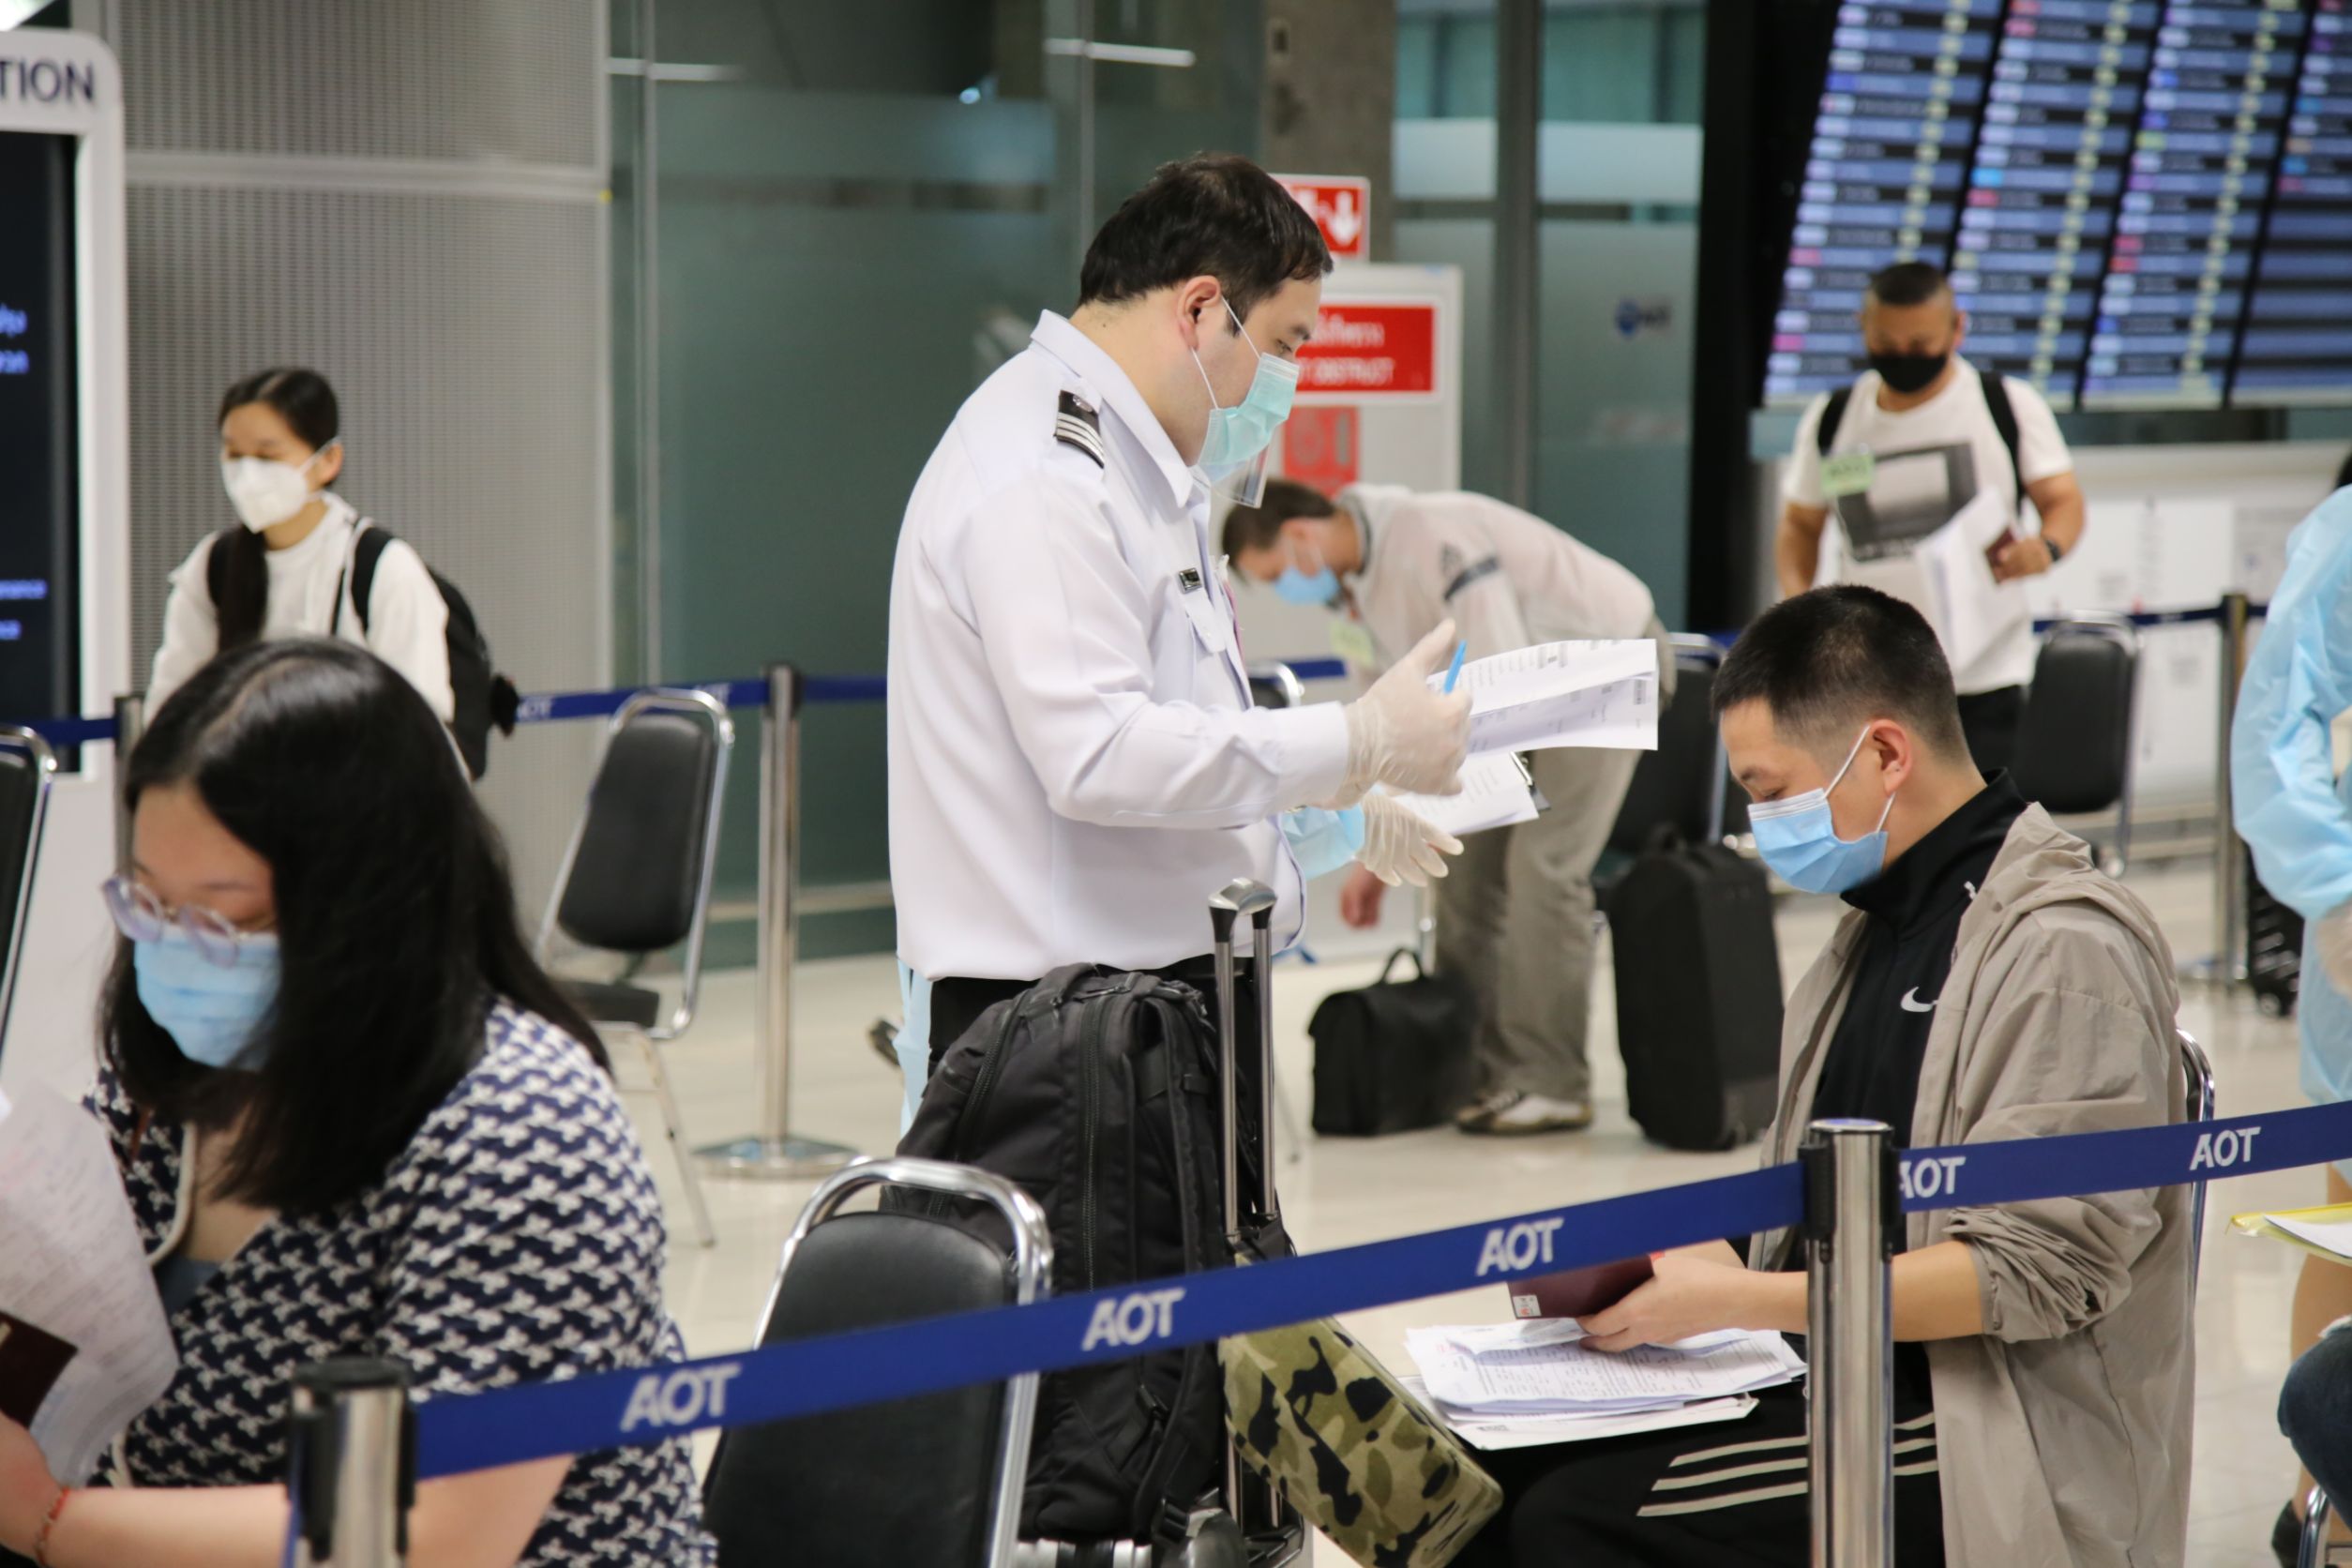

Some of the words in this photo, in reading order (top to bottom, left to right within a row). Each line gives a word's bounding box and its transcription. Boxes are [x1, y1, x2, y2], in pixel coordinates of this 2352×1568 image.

[2189, 1126, 2261, 1170] AOT
[1476, 1217, 1563, 1276] AOT
[1081, 1287, 1185, 1350] AOT
[620, 1363, 741, 1431] AOT
